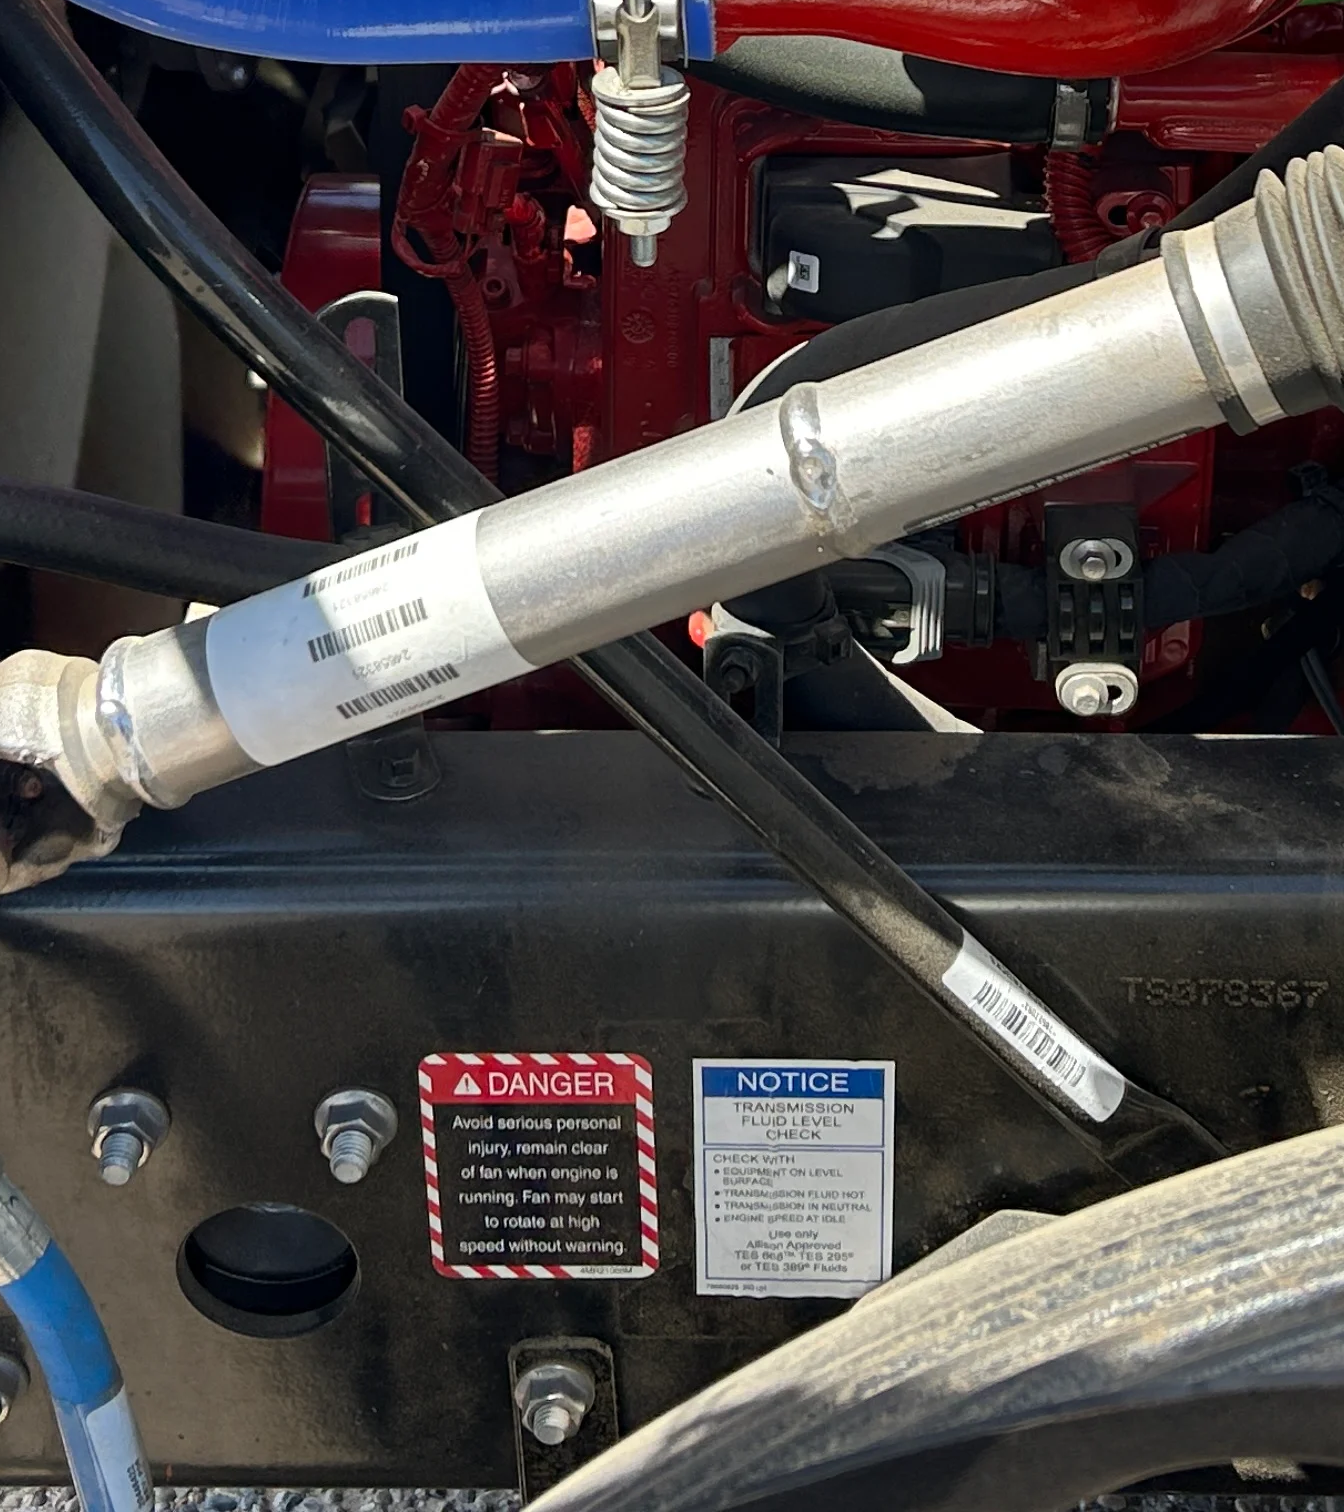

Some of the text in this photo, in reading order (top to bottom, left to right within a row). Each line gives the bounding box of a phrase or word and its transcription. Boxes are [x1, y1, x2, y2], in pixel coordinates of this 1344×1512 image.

[488, 1072, 615, 1096] DANGER
[738, 1071, 849, 1093] NOTICE
[733, 1102, 854, 1114] TRANSMISSION
[452, 1115, 622, 1133] Avoid serious personal
[742, 1115, 842, 1127] FLUID LEVEL
[766, 1128, 822, 1140] CHECK
[468, 1140, 609, 1158] injury, remain clear
[713, 1154, 795, 1165] CHECK WITH
[461, 1165, 619, 1182] of fan when engine is
[723, 1167, 843, 1177] EQUIPMENT ON LEVEL
[723, 1177, 773, 1187] SURFACE
[459, 1189, 624, 1207] running. Fan may start
[723, 1190, 866, 1200] TRANSMISSION FLUID HOT
[723, 1201, 872, 1211] TRANSMISSION IN NEUTRAL
[484, 1215, 600, 1232] to rotate at high
[723, 1214, 846, 1224] ENGINE SPEED AT IDLE
[768, 1229, 819, 1241] Use only
[459, 1238, 628, 1256] speed without warning.
[746, 1240, 842, 1251] Allison Approved
[740, 1263, 752, 1271] or
[813, 1262, 848, 1272] Fluids
